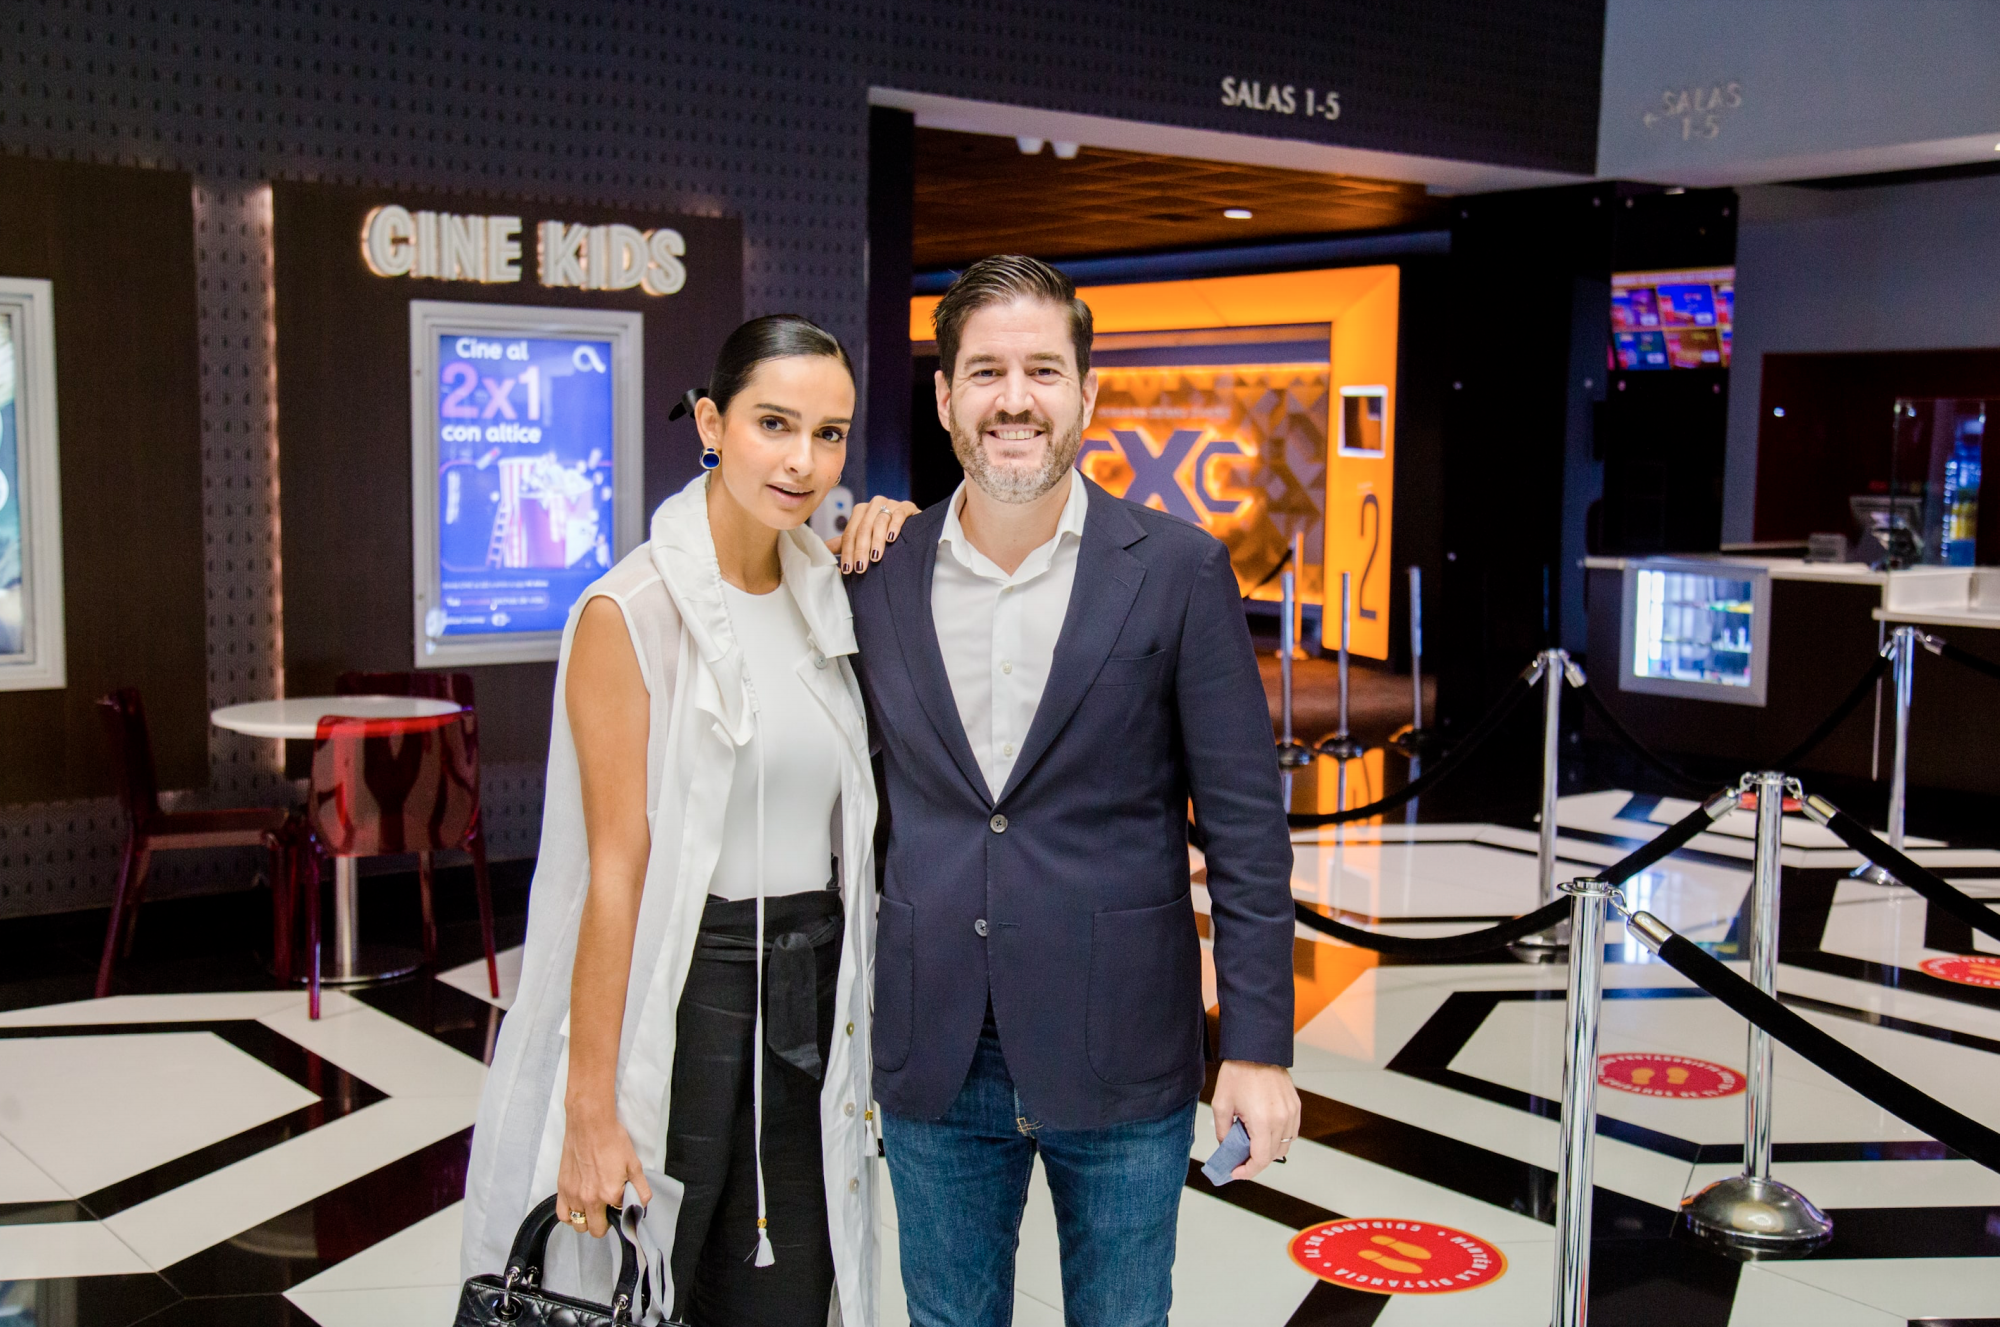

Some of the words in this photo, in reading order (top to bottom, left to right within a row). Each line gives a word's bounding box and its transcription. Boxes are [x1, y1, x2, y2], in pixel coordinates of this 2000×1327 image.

[1221, 76, 1296, 114] SALAS
[1306, 88, 1340, 120] 1-5
[1662, 83, 1742, 115] SALAS
[1682, 115, 1720, 141] 1-5
[362, 205, 522, 283] CINE
[537, 220, 687, 296] KIDS
[456, 337, 503, 361] Cine
[506, 341, 529, 361] al
[441, 361, 541, 421] 2x1
[441, 425, 482, 442] con
[485, 423, 542, 443] altice
[1359, 494, 1379, 620] 2
[1305, 1235, 1324, 1247] DE
[1321, 1221, 1421, 1236] CUIDAMOS
[1304, 1249, 1321, 1258] TI
[1450, 1236, 1492, 1270] MANTÉN
[1334, 1268, 1454, 1288] DISTANCIA
[1455, 1270, 1480, 1281] LA
